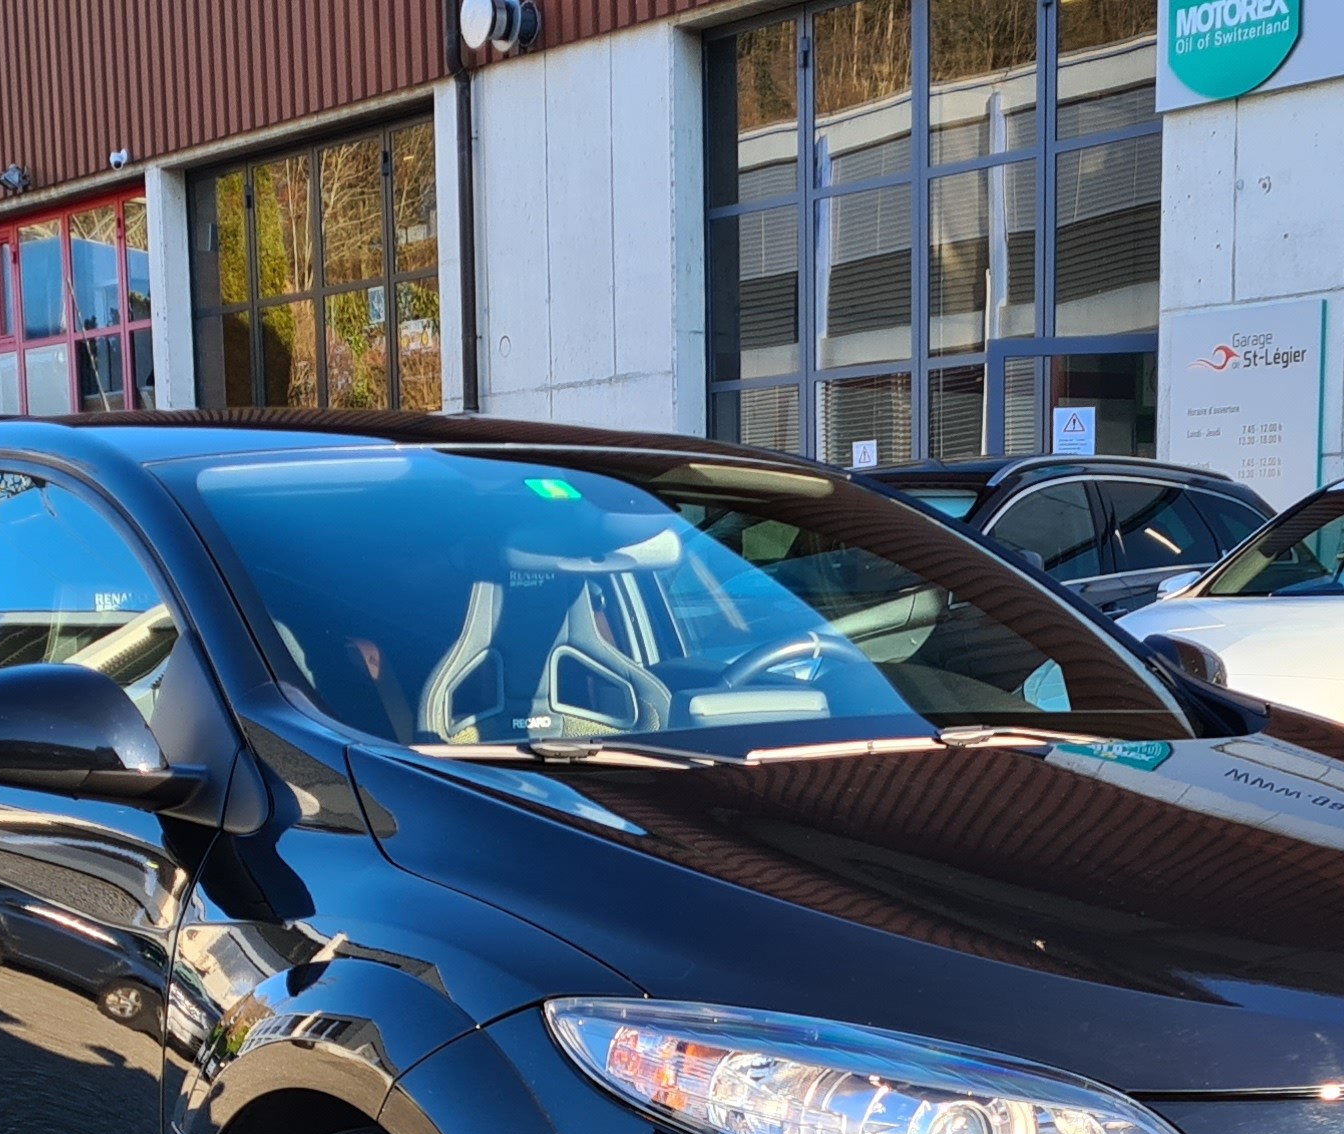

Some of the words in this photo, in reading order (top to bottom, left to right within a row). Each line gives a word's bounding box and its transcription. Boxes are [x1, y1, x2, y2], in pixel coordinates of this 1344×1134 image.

[1176, 38, 1193, 54] Oil
[1197, 33, 1210, 49] of
[1214, 16, 1290, 46] Switzerland
[1232, 333, 1273, 349] Garage
[1243, 346, 1307, 369] St-Légier
[512, 716, 551, 729] RECARO
